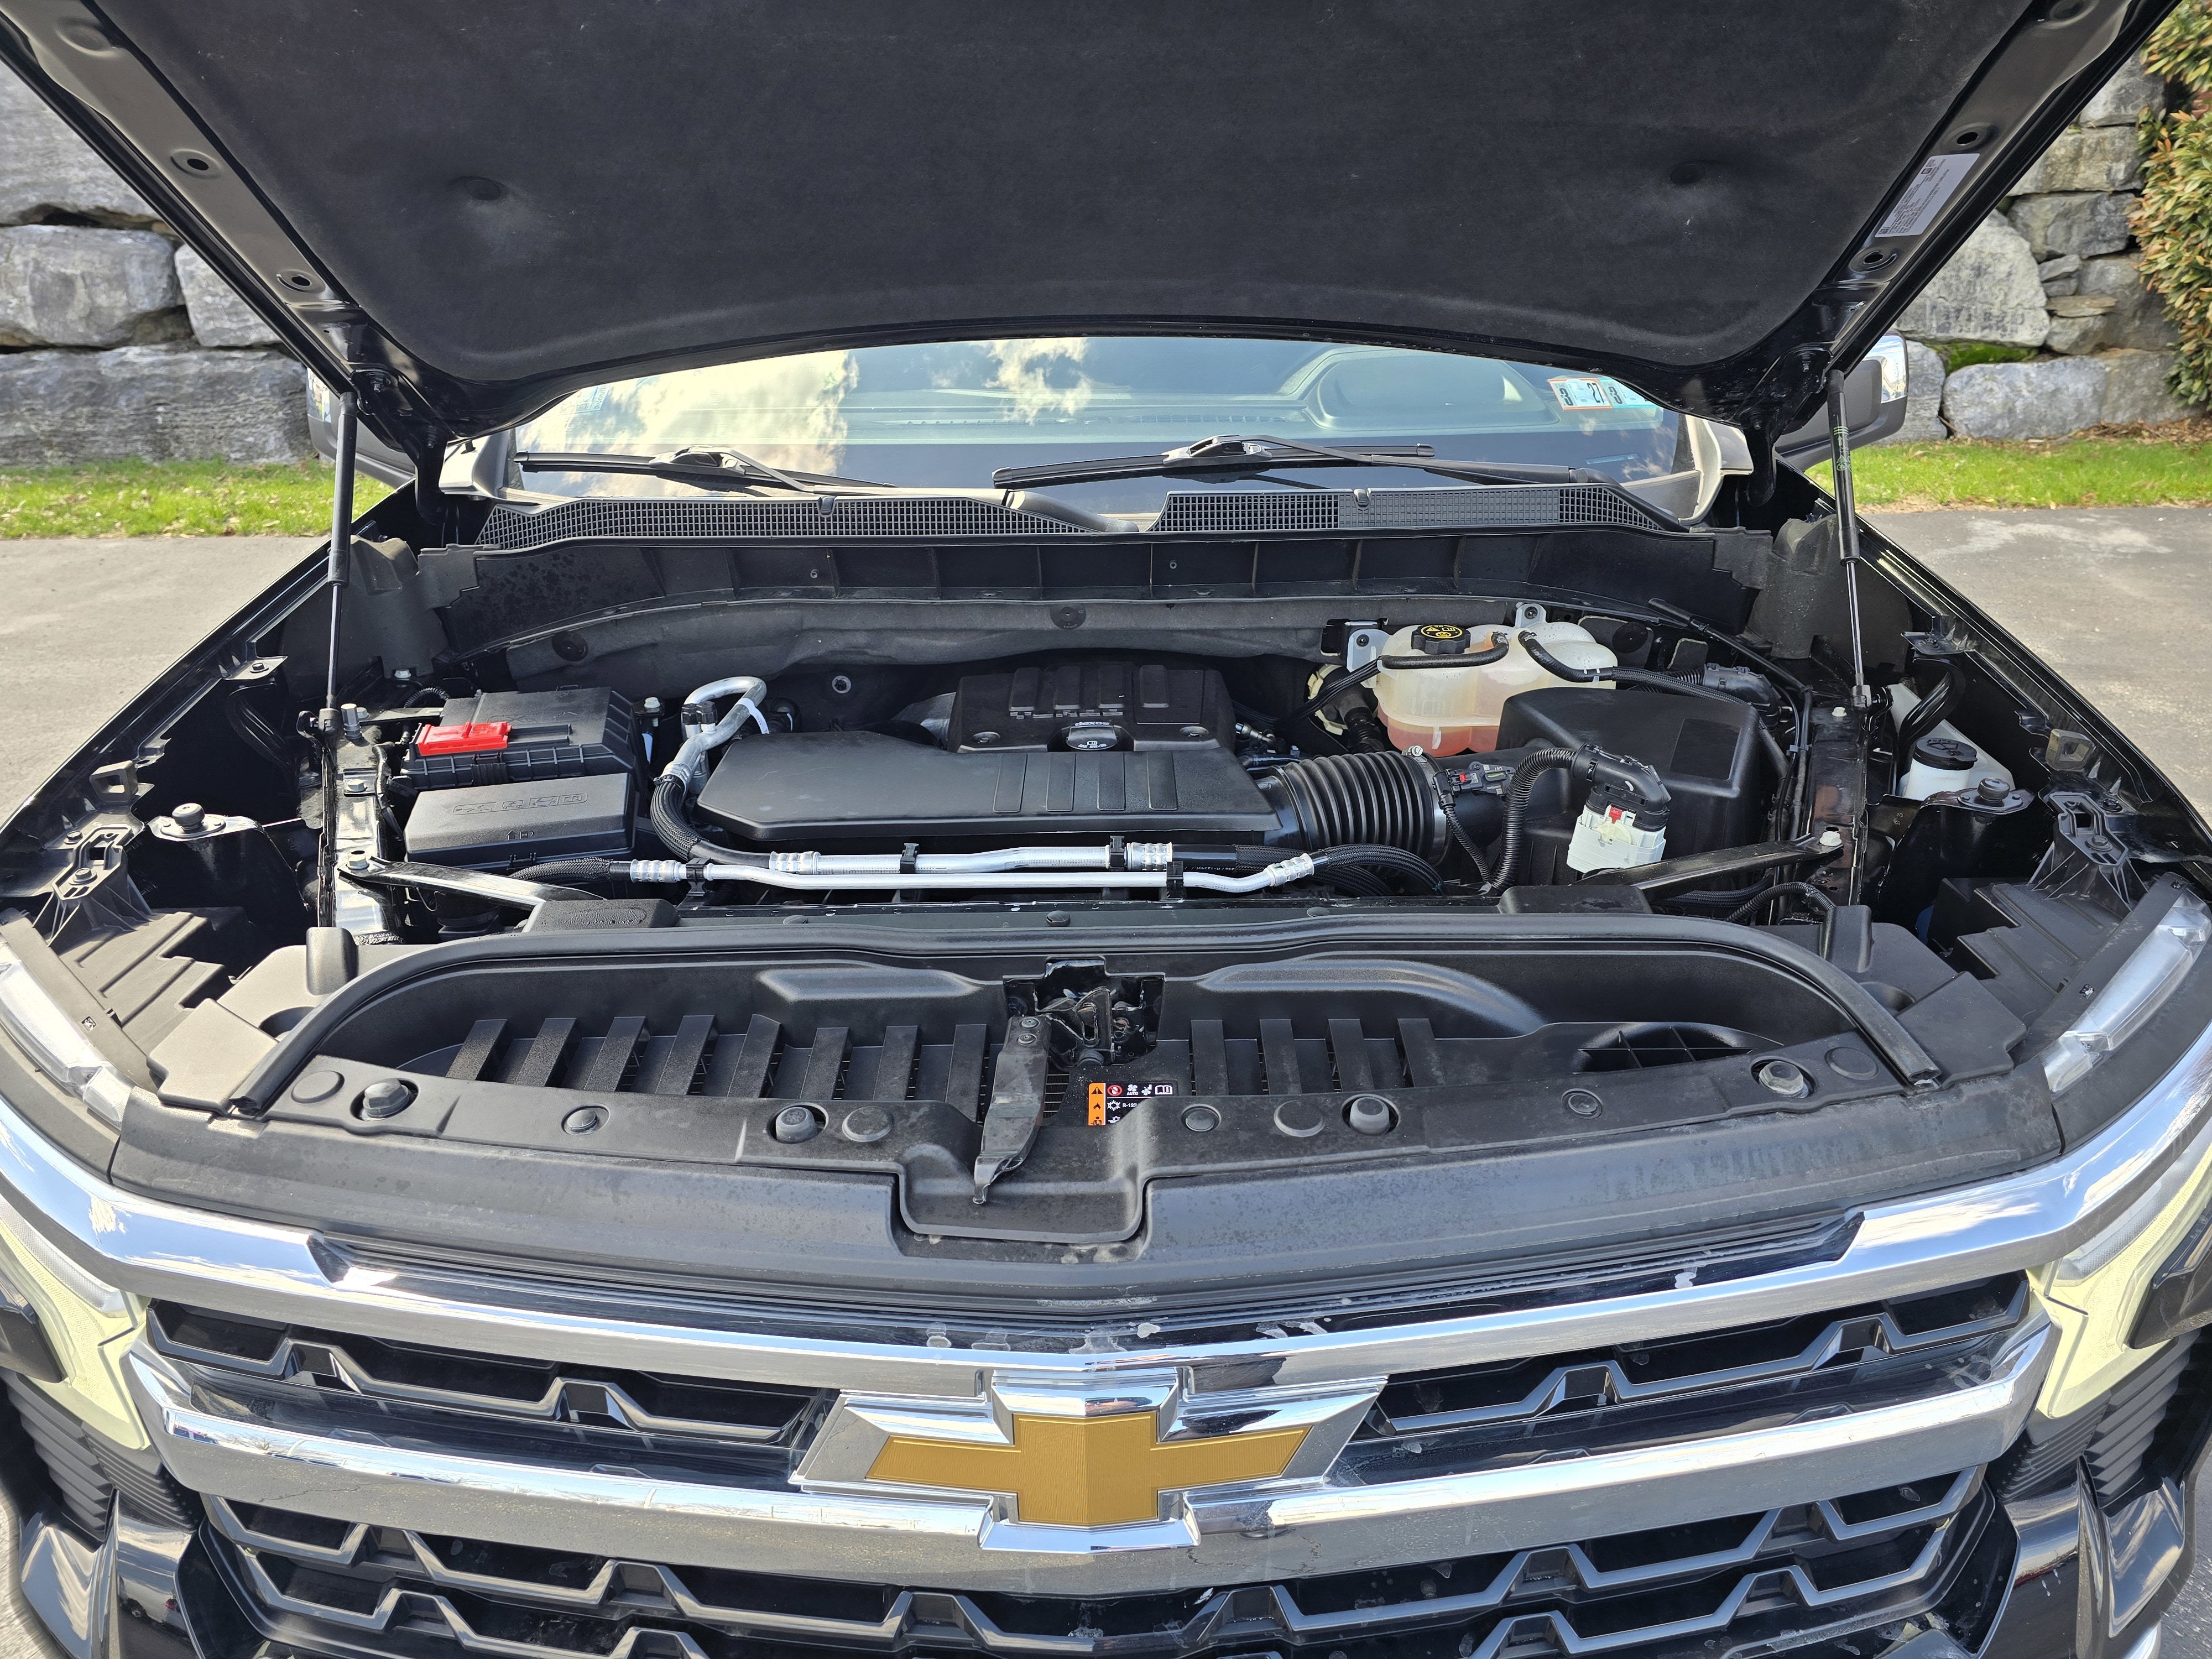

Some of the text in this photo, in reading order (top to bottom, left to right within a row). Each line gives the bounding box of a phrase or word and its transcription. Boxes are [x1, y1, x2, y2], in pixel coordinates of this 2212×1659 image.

[1559, 388, 1574, 406] 3
[1587, 383, 1604, 403] 27
[1608, 387, 1623, 404] 3
